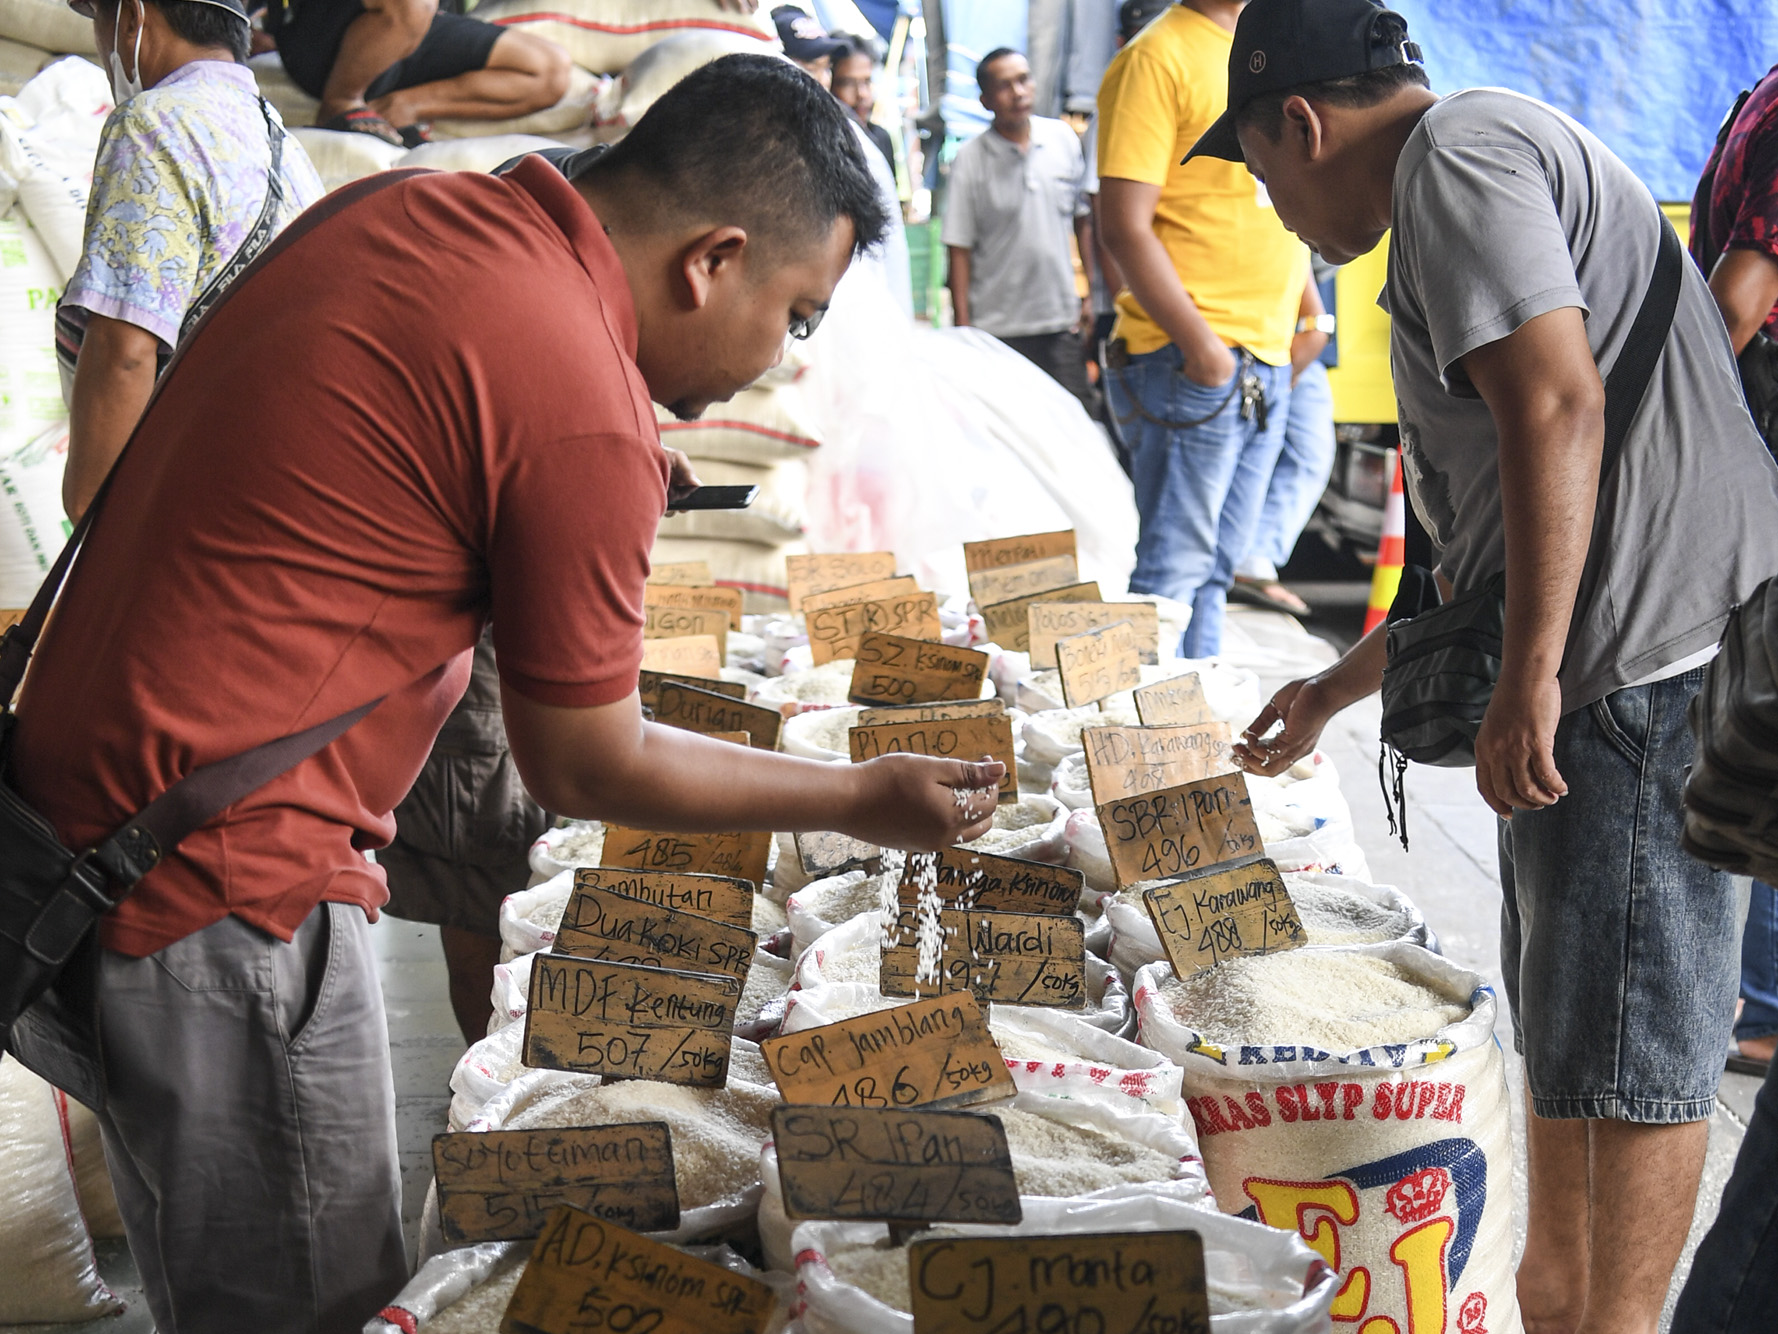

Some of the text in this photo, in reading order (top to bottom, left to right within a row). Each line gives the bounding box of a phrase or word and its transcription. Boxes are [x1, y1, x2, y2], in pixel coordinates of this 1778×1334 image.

[244, 229, 268, 260] FILA
[217, 263, 246, 293] FILA
[813, 607, 856, 641] ST
[892, 599, 937, 627] SPR
[862, 675, 917, 698] 500
[658, 686, 743, 732] Durian
[622, 837, 698, 871] 485
[1141, 834, 1201, 877] 496
[708, 942, 751, 976] SPR
[1196, 916, 1244, 967] 488
[571, 1030, 652, 1071] 507
[1274, 1081, 1364, 1123] SLYP
[1371, 1080, 1467, 1124] SUPER
